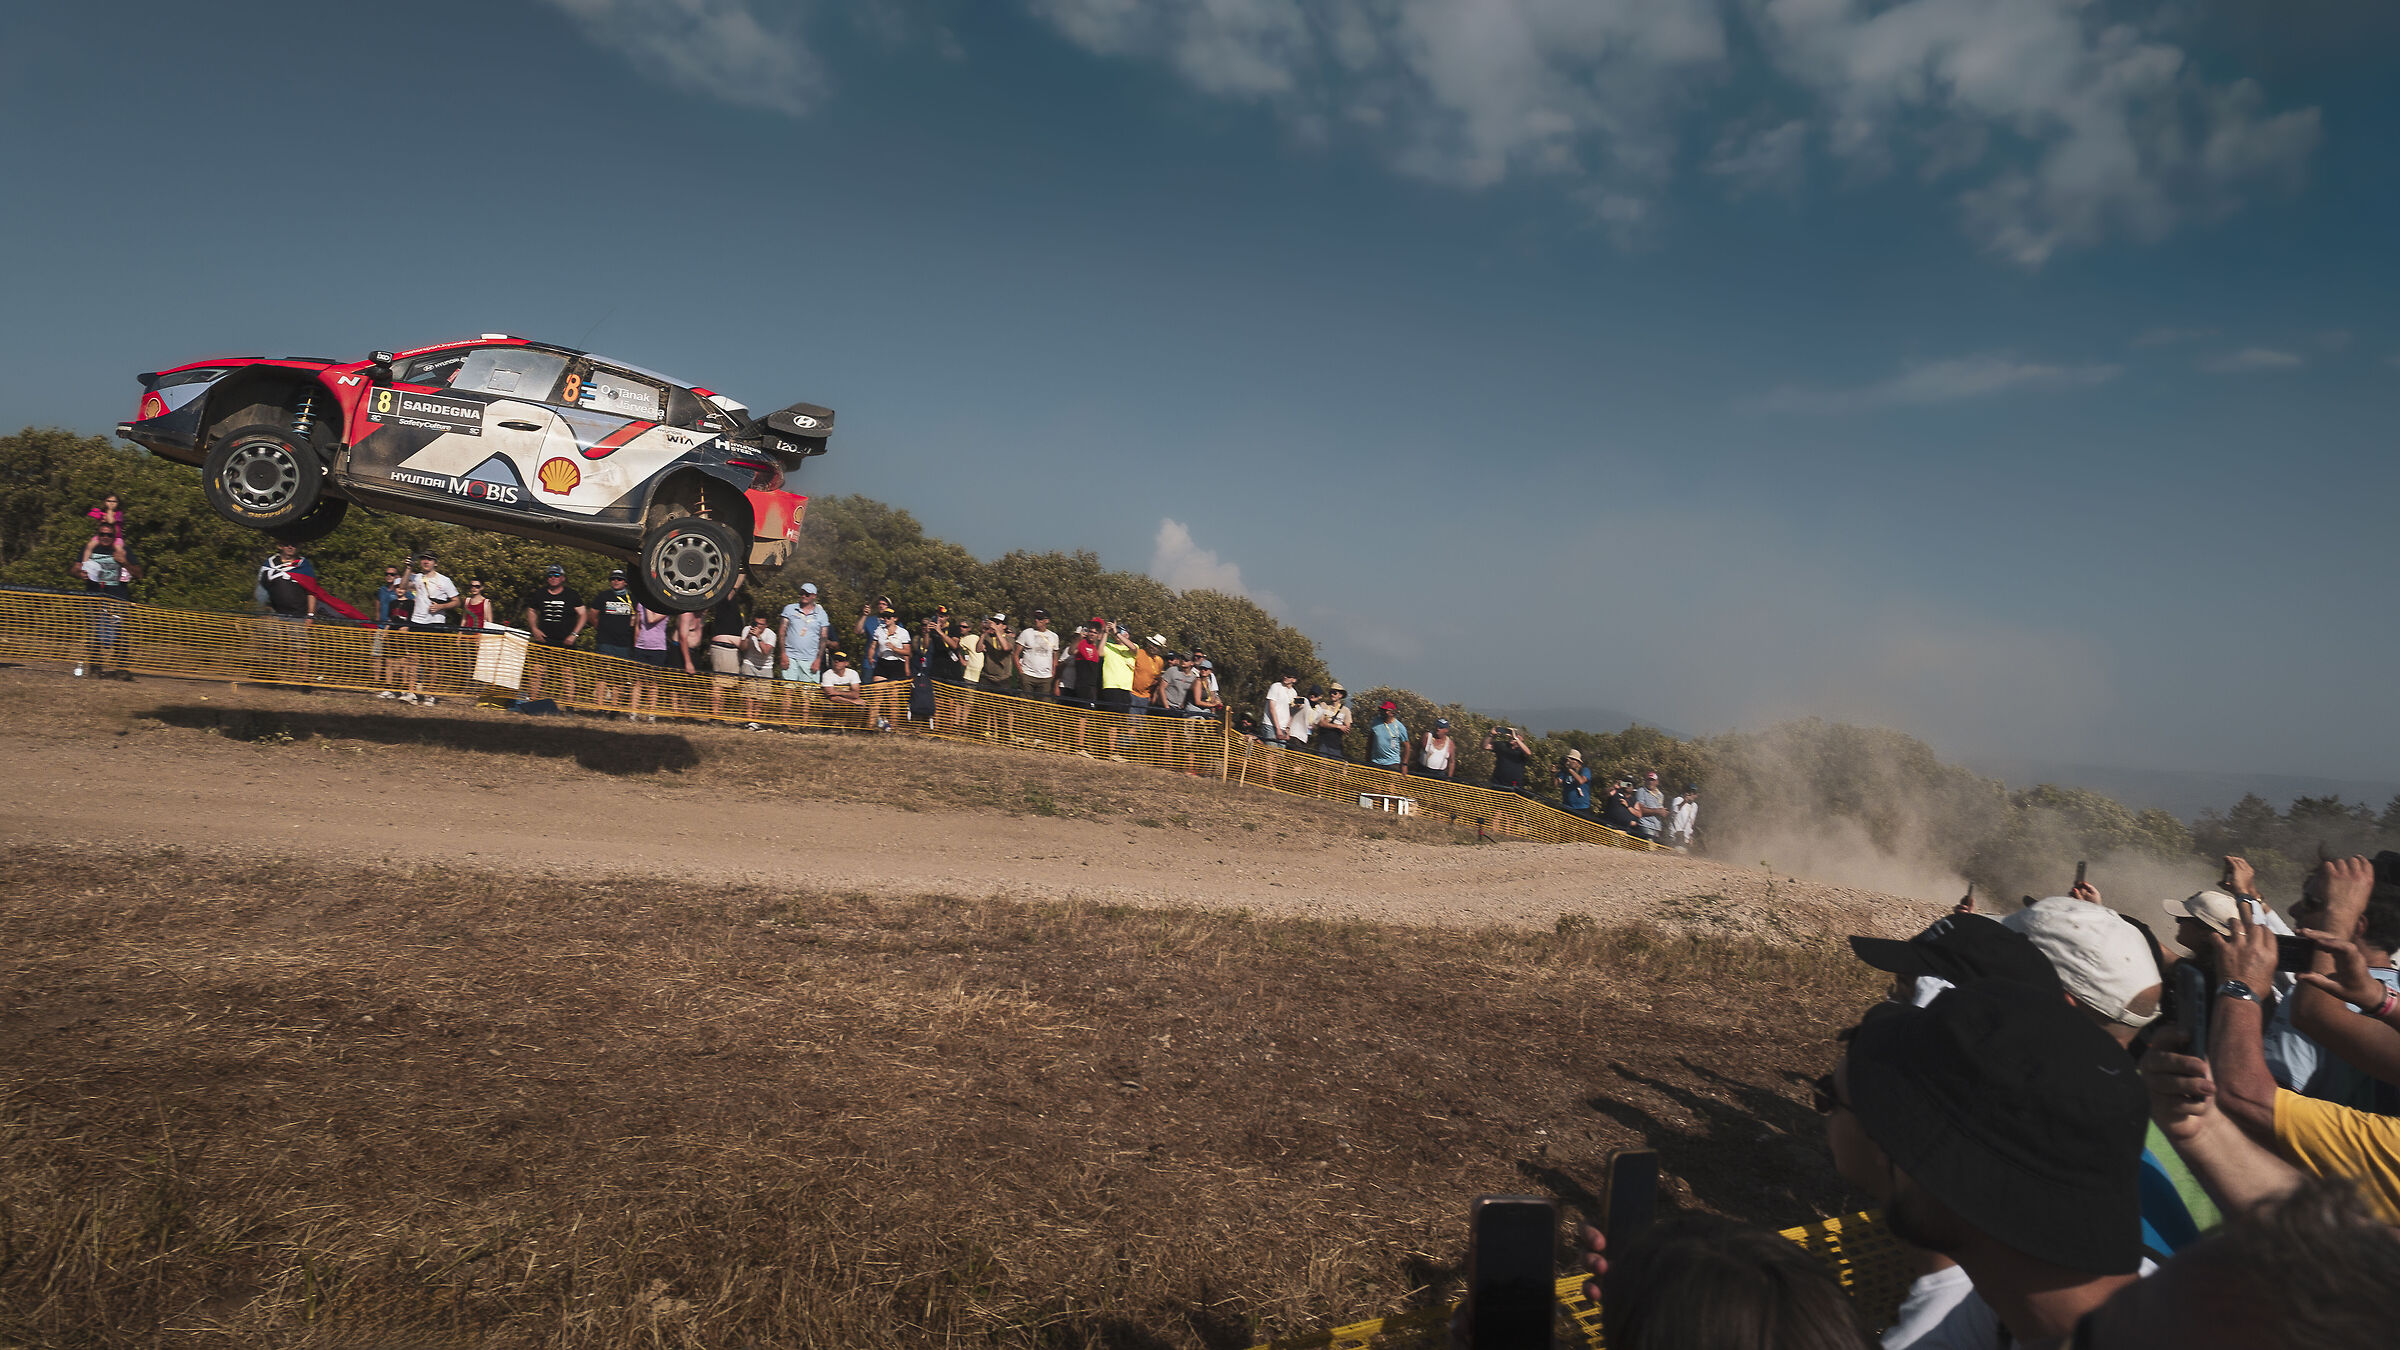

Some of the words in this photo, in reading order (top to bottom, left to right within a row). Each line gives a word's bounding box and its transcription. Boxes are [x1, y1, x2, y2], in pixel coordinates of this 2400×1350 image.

[434, 358, 460, 368] HYUNDAI
[337, 375, 360, 386] N
[563, 374, 581, 402] 8
[377, 391, 392, 413] 8
[403, 400, 480, 420] SARDEGNA
[398, 418, 452, 431] SafetyCulture
[390, 471, 446, 489] HYUNDAI
[447, 477, 519, 504] MOBIS
